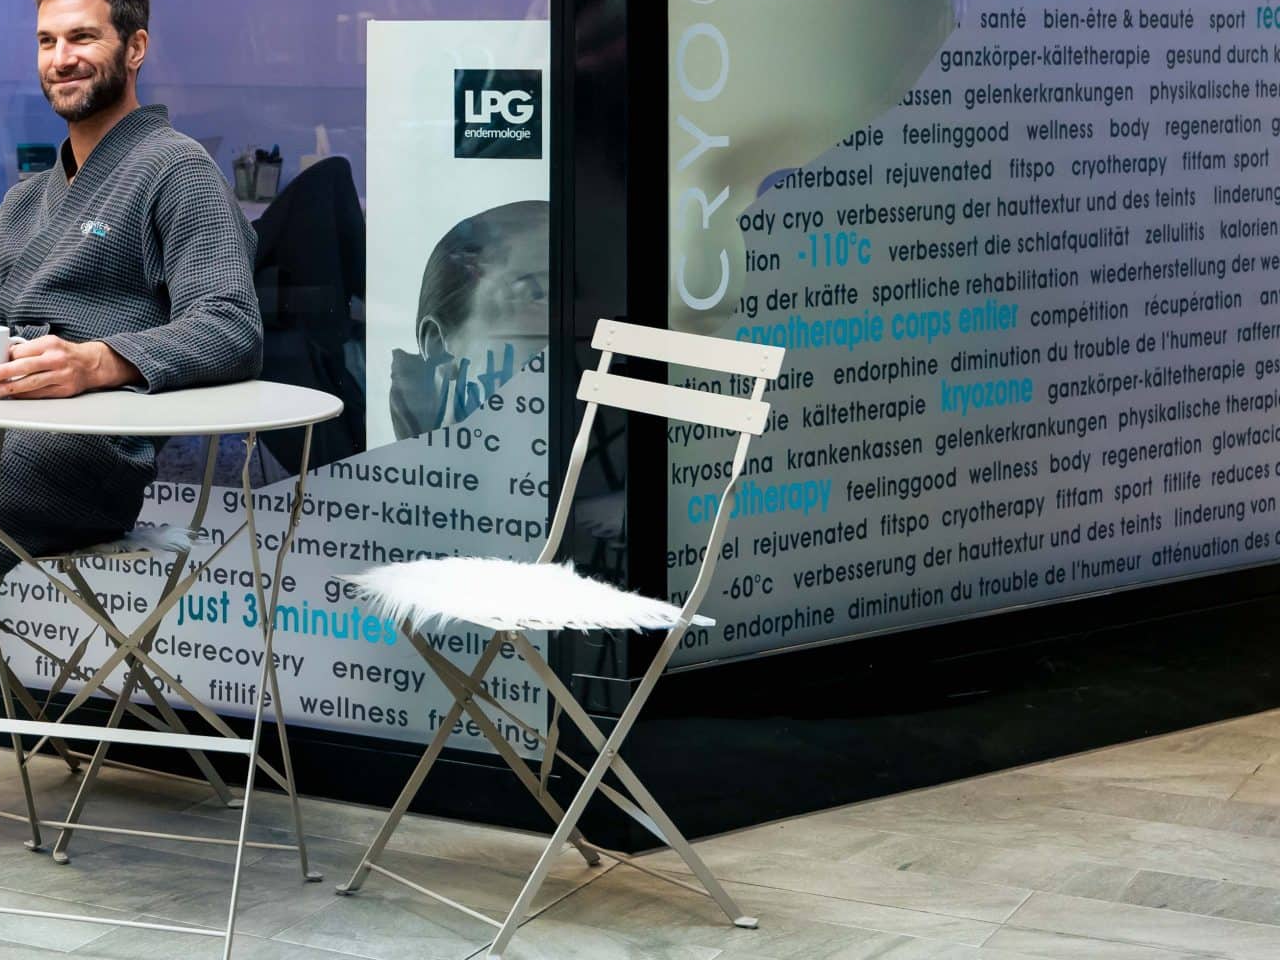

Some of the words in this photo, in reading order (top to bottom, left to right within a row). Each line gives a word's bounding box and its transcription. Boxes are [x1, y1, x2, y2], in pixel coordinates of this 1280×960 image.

[1044, 8, 1117, 28] bien-être
[941, 45, 1150, 72] ganzkörper-kältetherapie
[1166, 45, 1221, 69] gesund
[464, 90, 534, 124] LPG
[965, 83, 1133, 110] gelenkerkrankungen
[1150, 80, 1249, 104] physikalische
[464, 128, 531, 140] endermologie
[903, 121, 1008, 148] feelinggood
[1027, 120, 1093, 140] wellness
[1166, 115, 1261, 140] regeneration
[887, 160, 991, 188] rejuvenated
[1072, 155, 1166, 179] cryotherapy
[837, 204, 955, 225] verbesserung
[998, 194, 1080, 216] hauttextur
[889, 236, 978, 261] verbessert
[1018, 227, 1129, 253] schlafqualität
[1146, 222, 1204, 244] zellulitis
[805, 284, 857, 307] kräfte
[873, 277, 959, 305] sportliche
[967, 268, 1078, 294] rehabilitation
[1090, 258, 1225, 284] wiederherstellung
[892, 310, 951, 342] corps
[958, 300, 1017, 333] entier
[1031, 301, 1128, 328] compétition
[1145, 291, 1241, 317] récupération
[834, 356, 938, 384] endorphine
[951, 346, 1040, 372] diminution
[1074, 336, 1130, 359] trouble
[1162, 330, 1227, 350] l'humeur
[803, 395, 925, 428] kältetherapie
[941, 378, 1033, 416] kryozone
[1048, 360, 1245, 404] ganzkörper-kältetherapie
[788, 438, 922, 470] krankenkassen
[936, 415, 1106, 456] gelenkerkrankungen
[1119, 398, 1220, 431] physikalische
[331, 464, 479, 492] musculaire
[847, 467, 956, 501] feelinggood
[969, 461, 1037, 484] wellness
[1103, 437, 1201, 468] regeneration
[754, 518, 867, 557] rejuvenated
[942, 497, 1044, 528] cryotherapy
[1212, 464, 1269, 486] reduces
[794, 555, 916, 588] verbesserung
[959, 532, 1044, 562] hauttextur
[1175, 502, 1245, 527] linderung
[724, 606, 834, 644] endorphine
[848, 588, 943, 621] diminution
[979, 570, 1038, 597] trouble
[1072, 555, 1141, 581] l'humeur
[1152, 538, 1238, 566] atténuation
[178, 591, 229, 626] just
[243, 593, 258, 628] 3
[271, 600, 398, 646] minutes
[333, 662, 425, 693] energy
[300, 696, 408, 727] wellness
